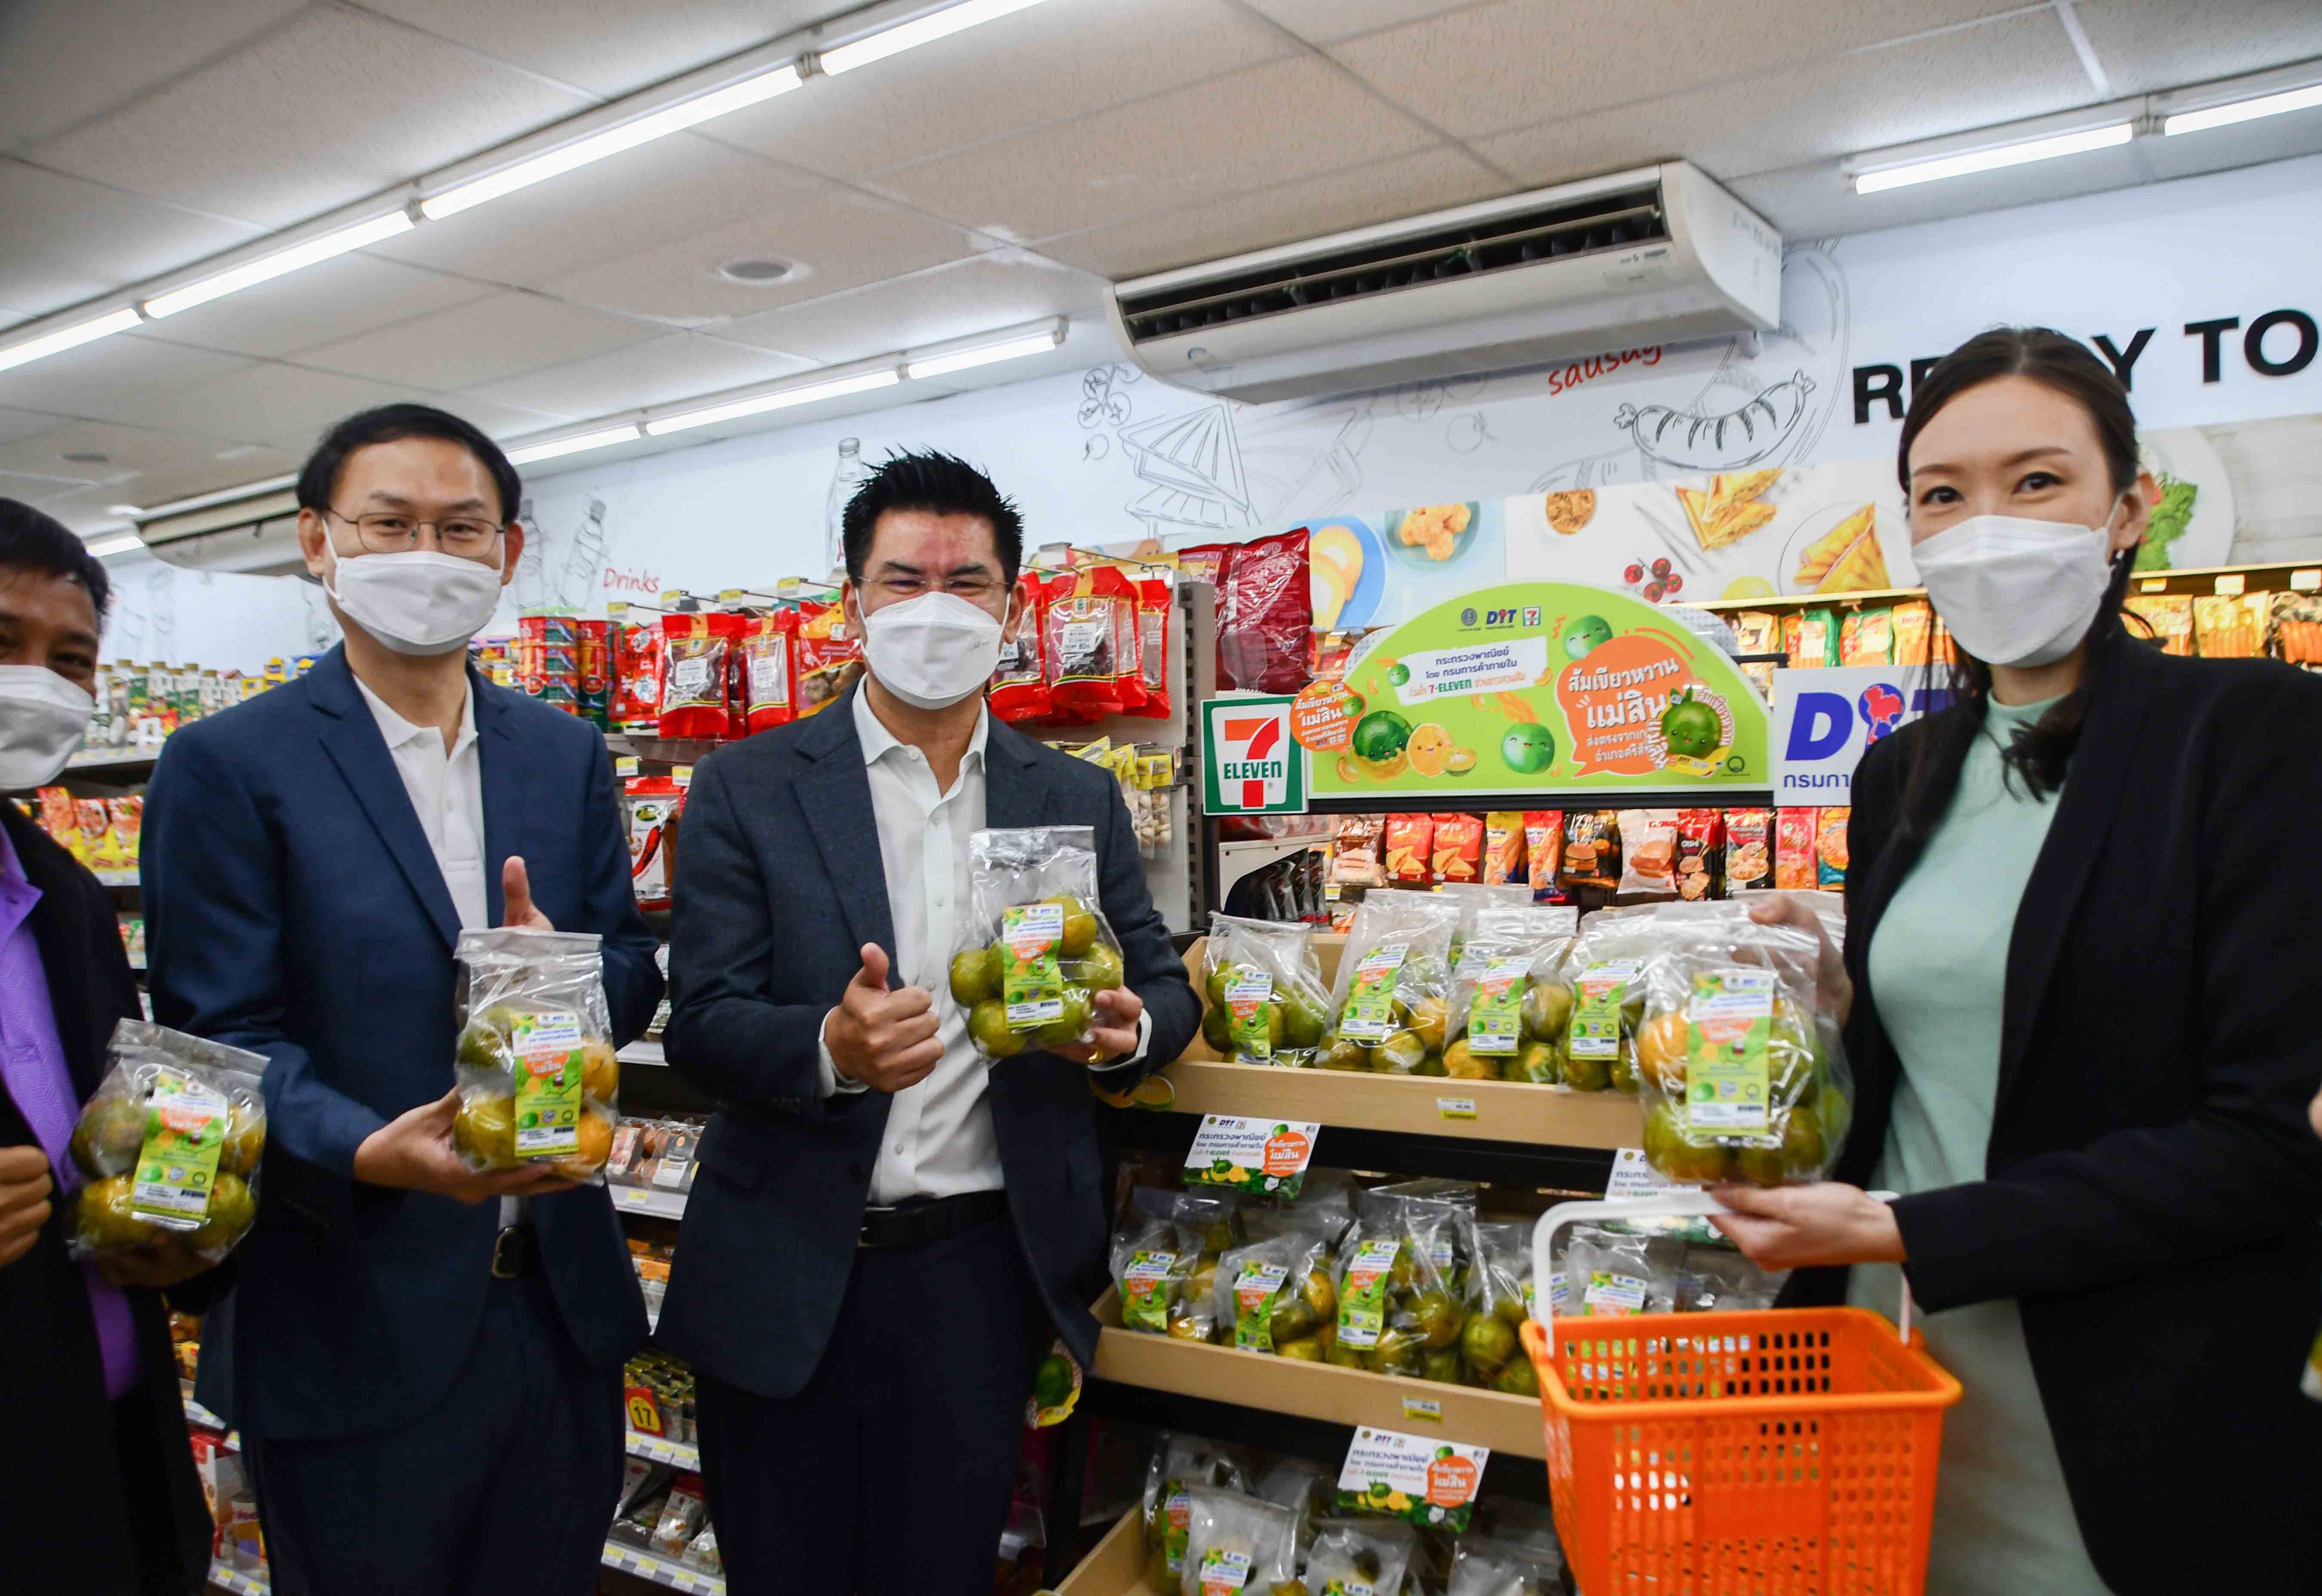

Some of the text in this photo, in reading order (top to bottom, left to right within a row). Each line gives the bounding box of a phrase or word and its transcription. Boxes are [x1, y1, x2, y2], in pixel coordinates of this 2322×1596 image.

[2184, 308, 2319, 384] TO
[1548, 344, 1662, 396] sausag
[603, 568, 659, 592] Drinks
[1436, 646, 1510, 665] กระทรวงพาณิชย์
[1426, 659, 1517, 679] โดย กรมการค้าภายใน
[1568, 657, 1679, 692] ส้มเขียวหวาน
[1302, 707, 1342, 727] แม่สิน
[1586, 690, 1667, 728] แม่สิน
[1783, 774, 1849, 788] กรมกา
[1198, 1133, 1267, 1141] กระทรวงพาณิชย์
[634, 1406, 652, 1426] 17
